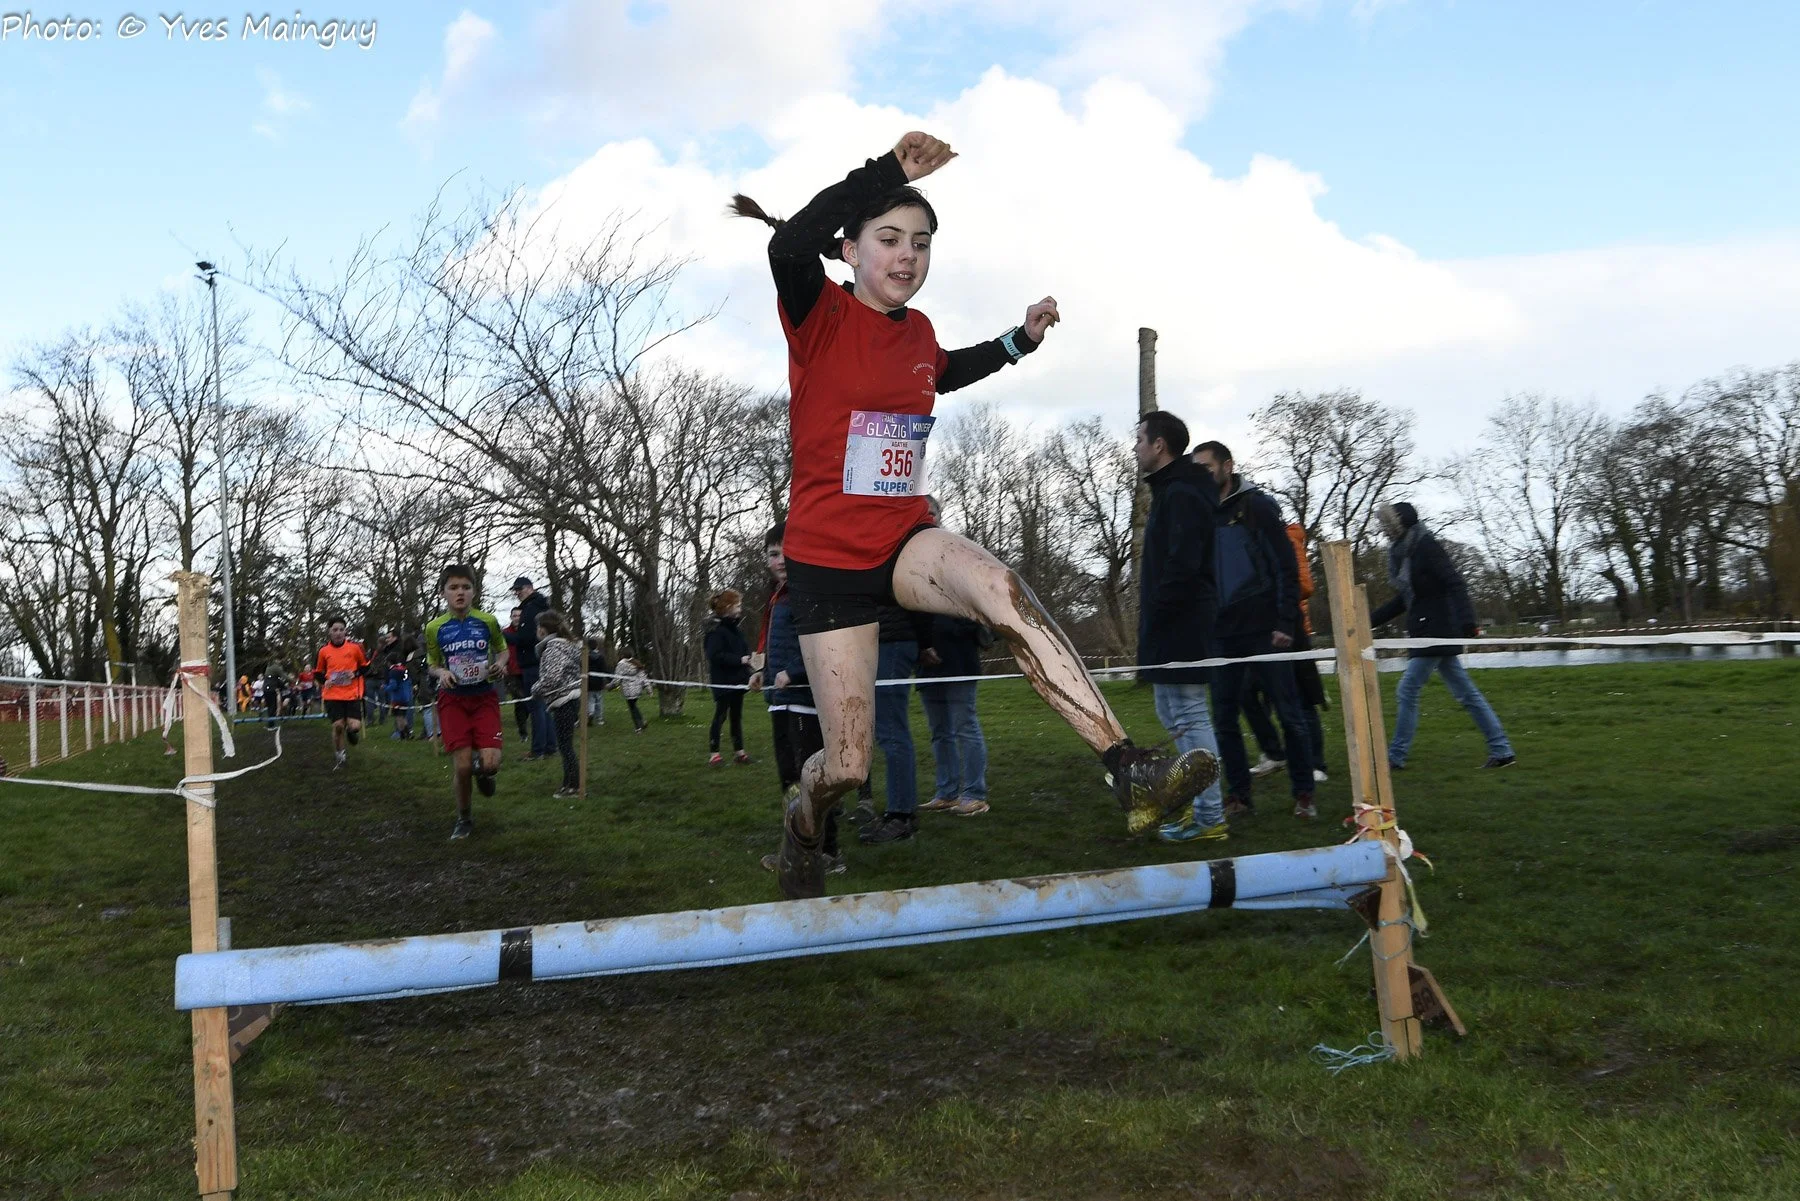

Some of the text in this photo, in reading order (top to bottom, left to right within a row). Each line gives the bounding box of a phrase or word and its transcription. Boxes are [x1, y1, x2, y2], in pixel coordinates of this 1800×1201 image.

[867, 422, 906, 438] GLAZIG
[880, 449, 913, 477] 356
[873, 480, 908, 493] SUPER
[442, 640, 475, 652] SUPER
